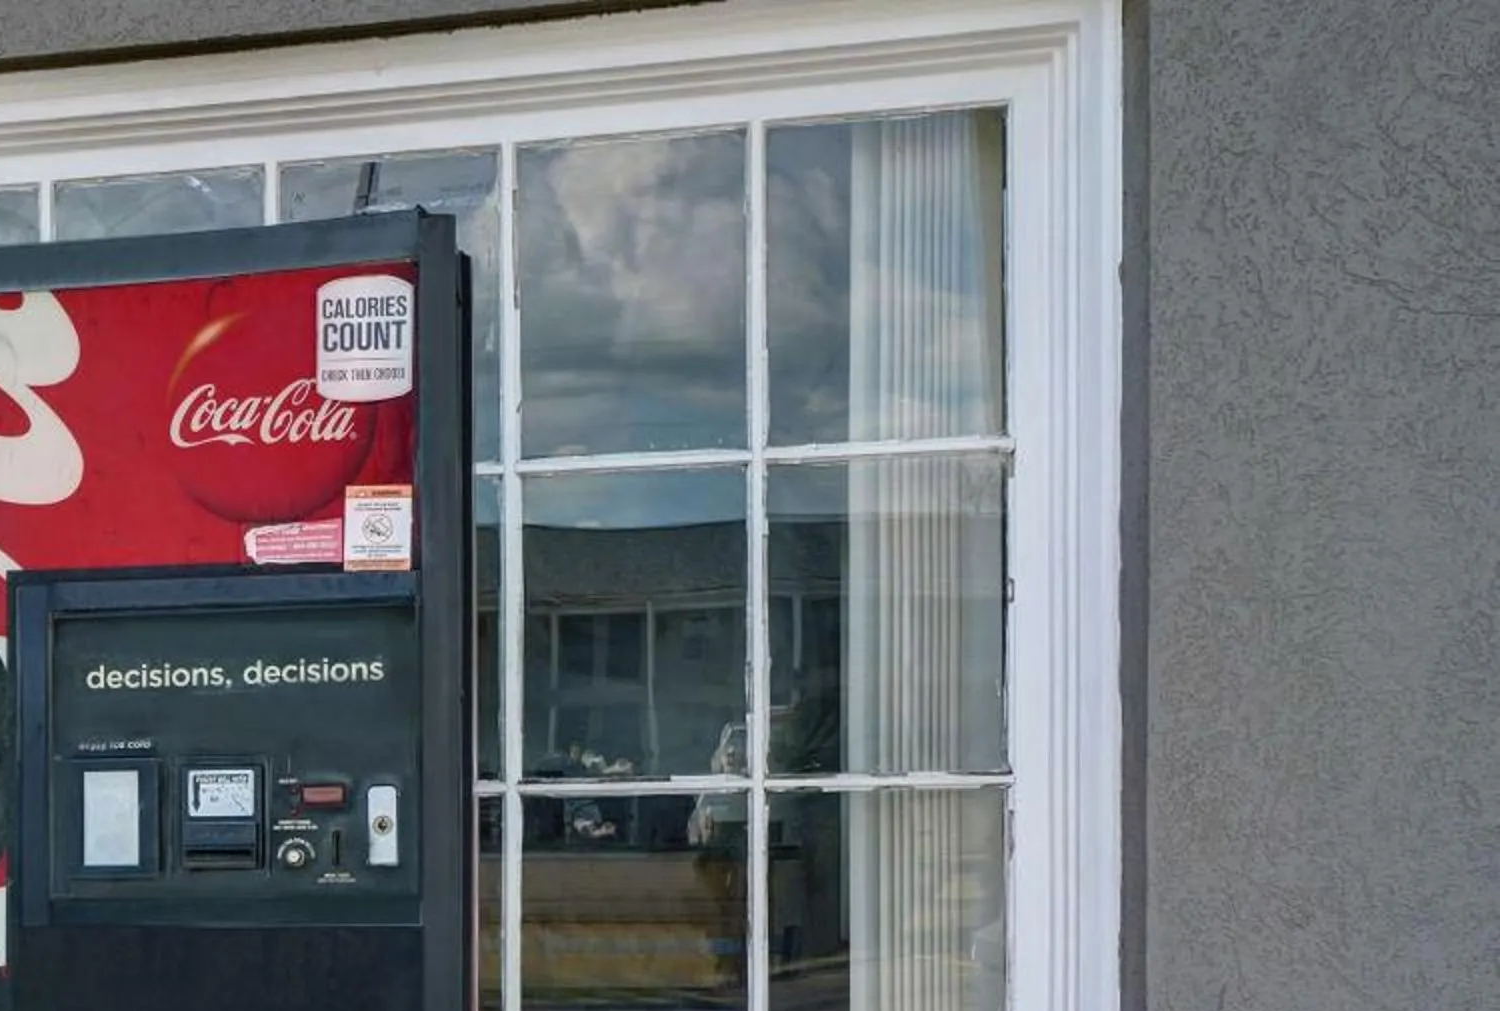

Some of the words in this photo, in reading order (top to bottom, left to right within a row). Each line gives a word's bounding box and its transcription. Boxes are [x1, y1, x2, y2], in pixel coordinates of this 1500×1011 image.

[322, 296, 407, 319] CALORIES
[322, 320, 407, 352] COUNT
[169, 378, 354, 449] Coca-Cola
[86, 661, 234, 690] decisions,
[243, 657, 385, 687] decisions
